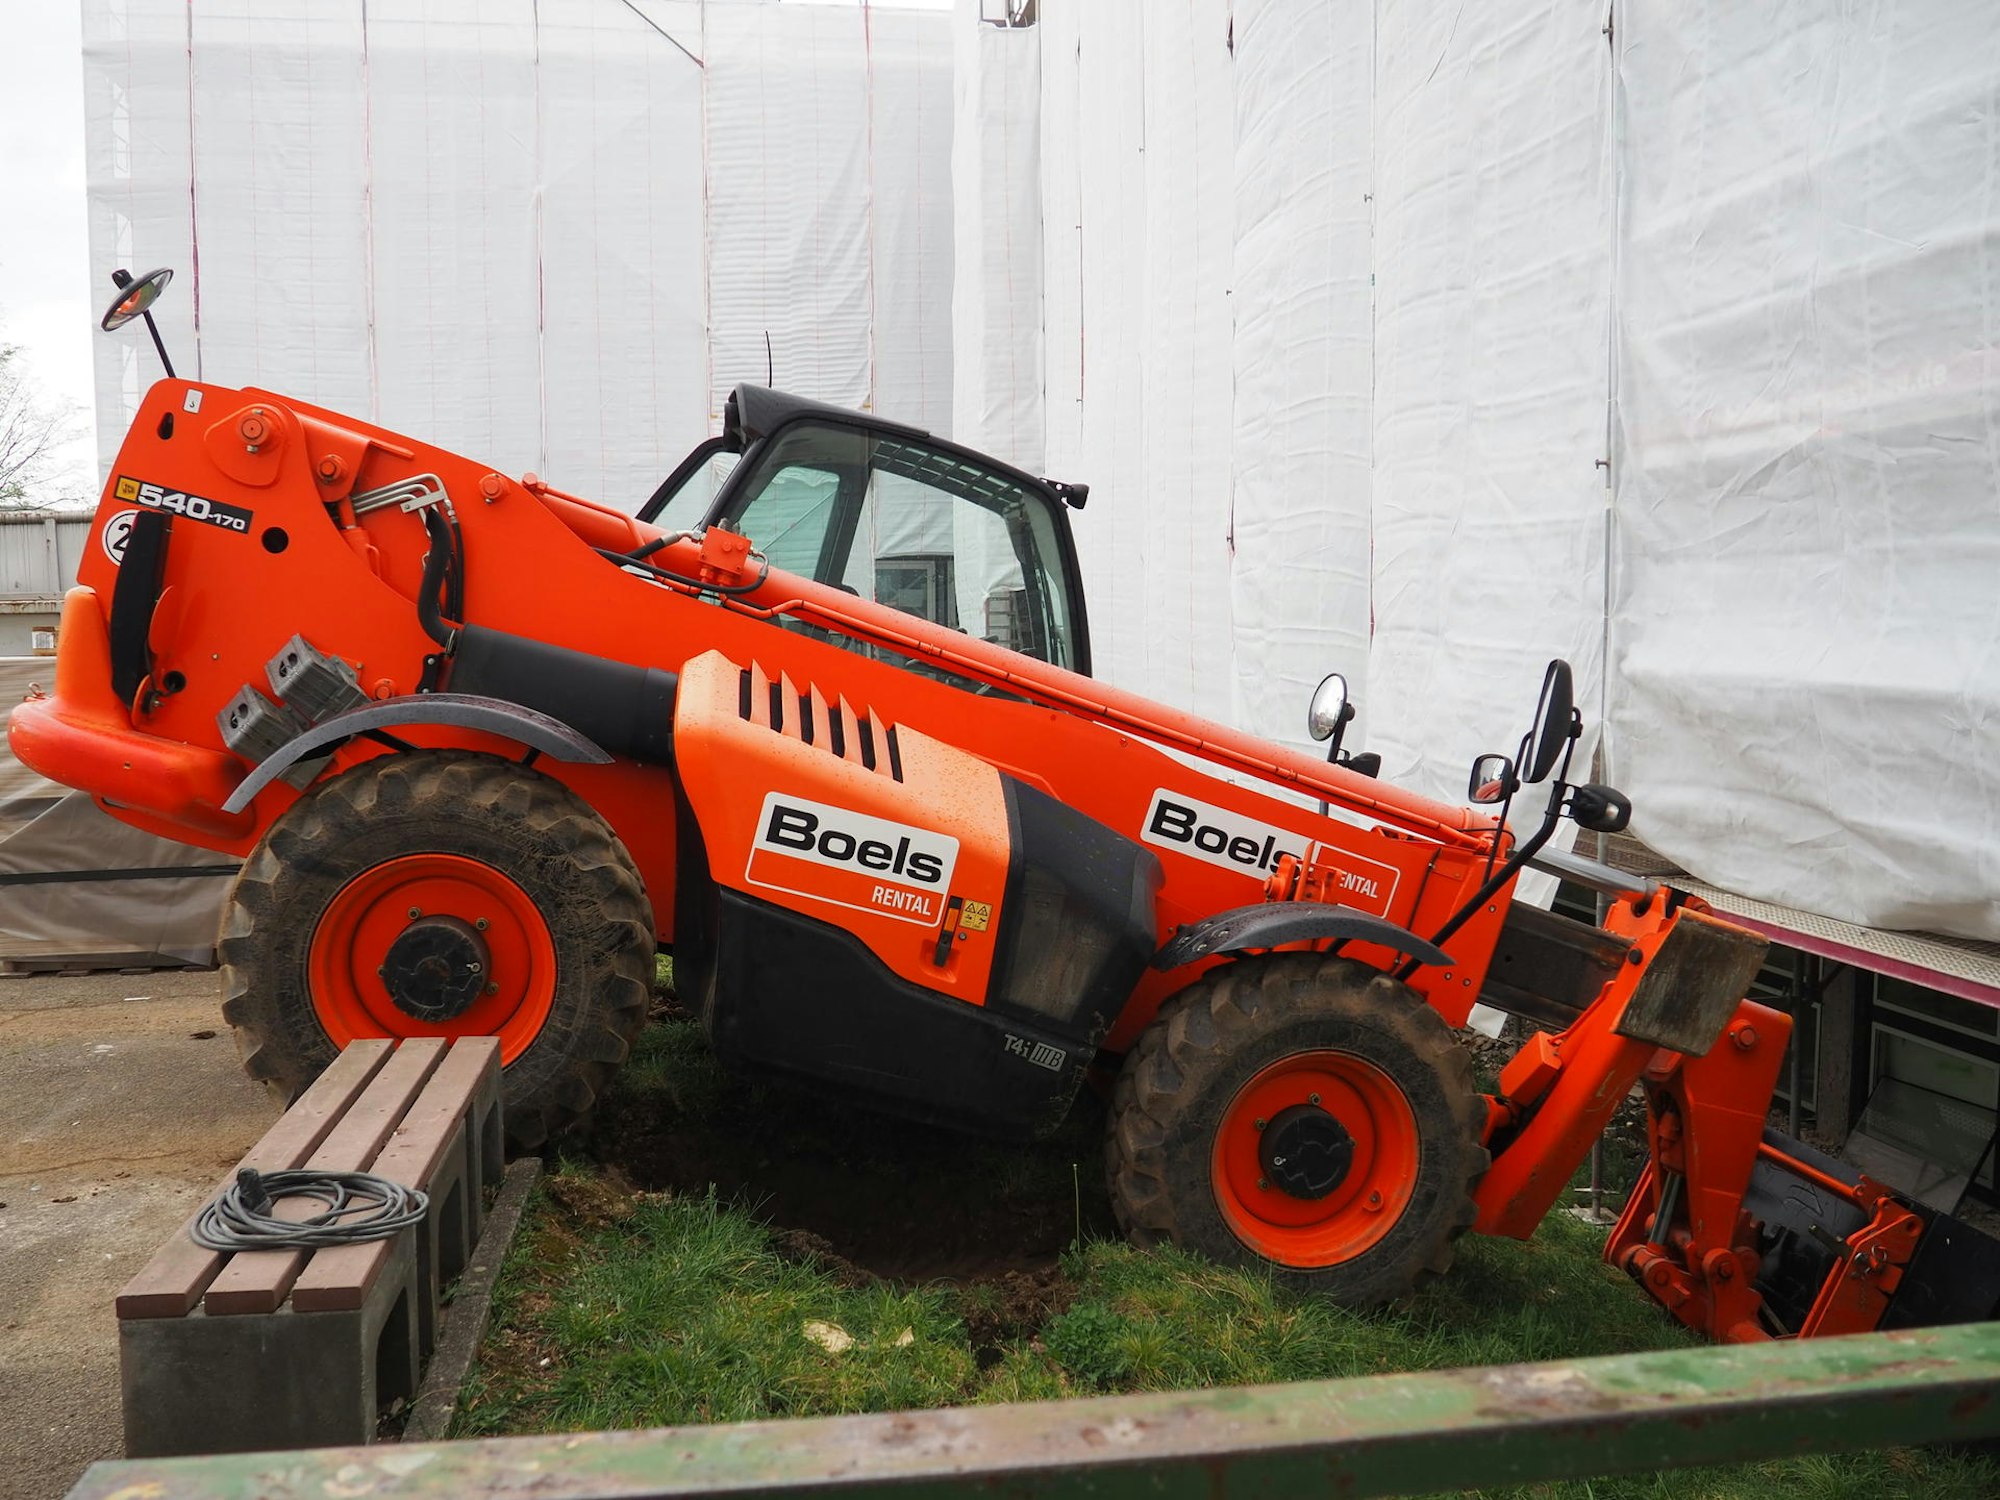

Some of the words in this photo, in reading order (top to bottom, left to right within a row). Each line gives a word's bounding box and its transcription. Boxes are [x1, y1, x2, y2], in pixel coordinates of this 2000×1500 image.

[138, 482, 246, 531] 540-170
[113, 523, 132, 552] 2
[766, 804, 943, 883] Boels
[1339, 871, 1378, 899] NTAL
[872, 885, 932, 916] RENTAL
[1004, 1033, 1031, 1058] T4i
